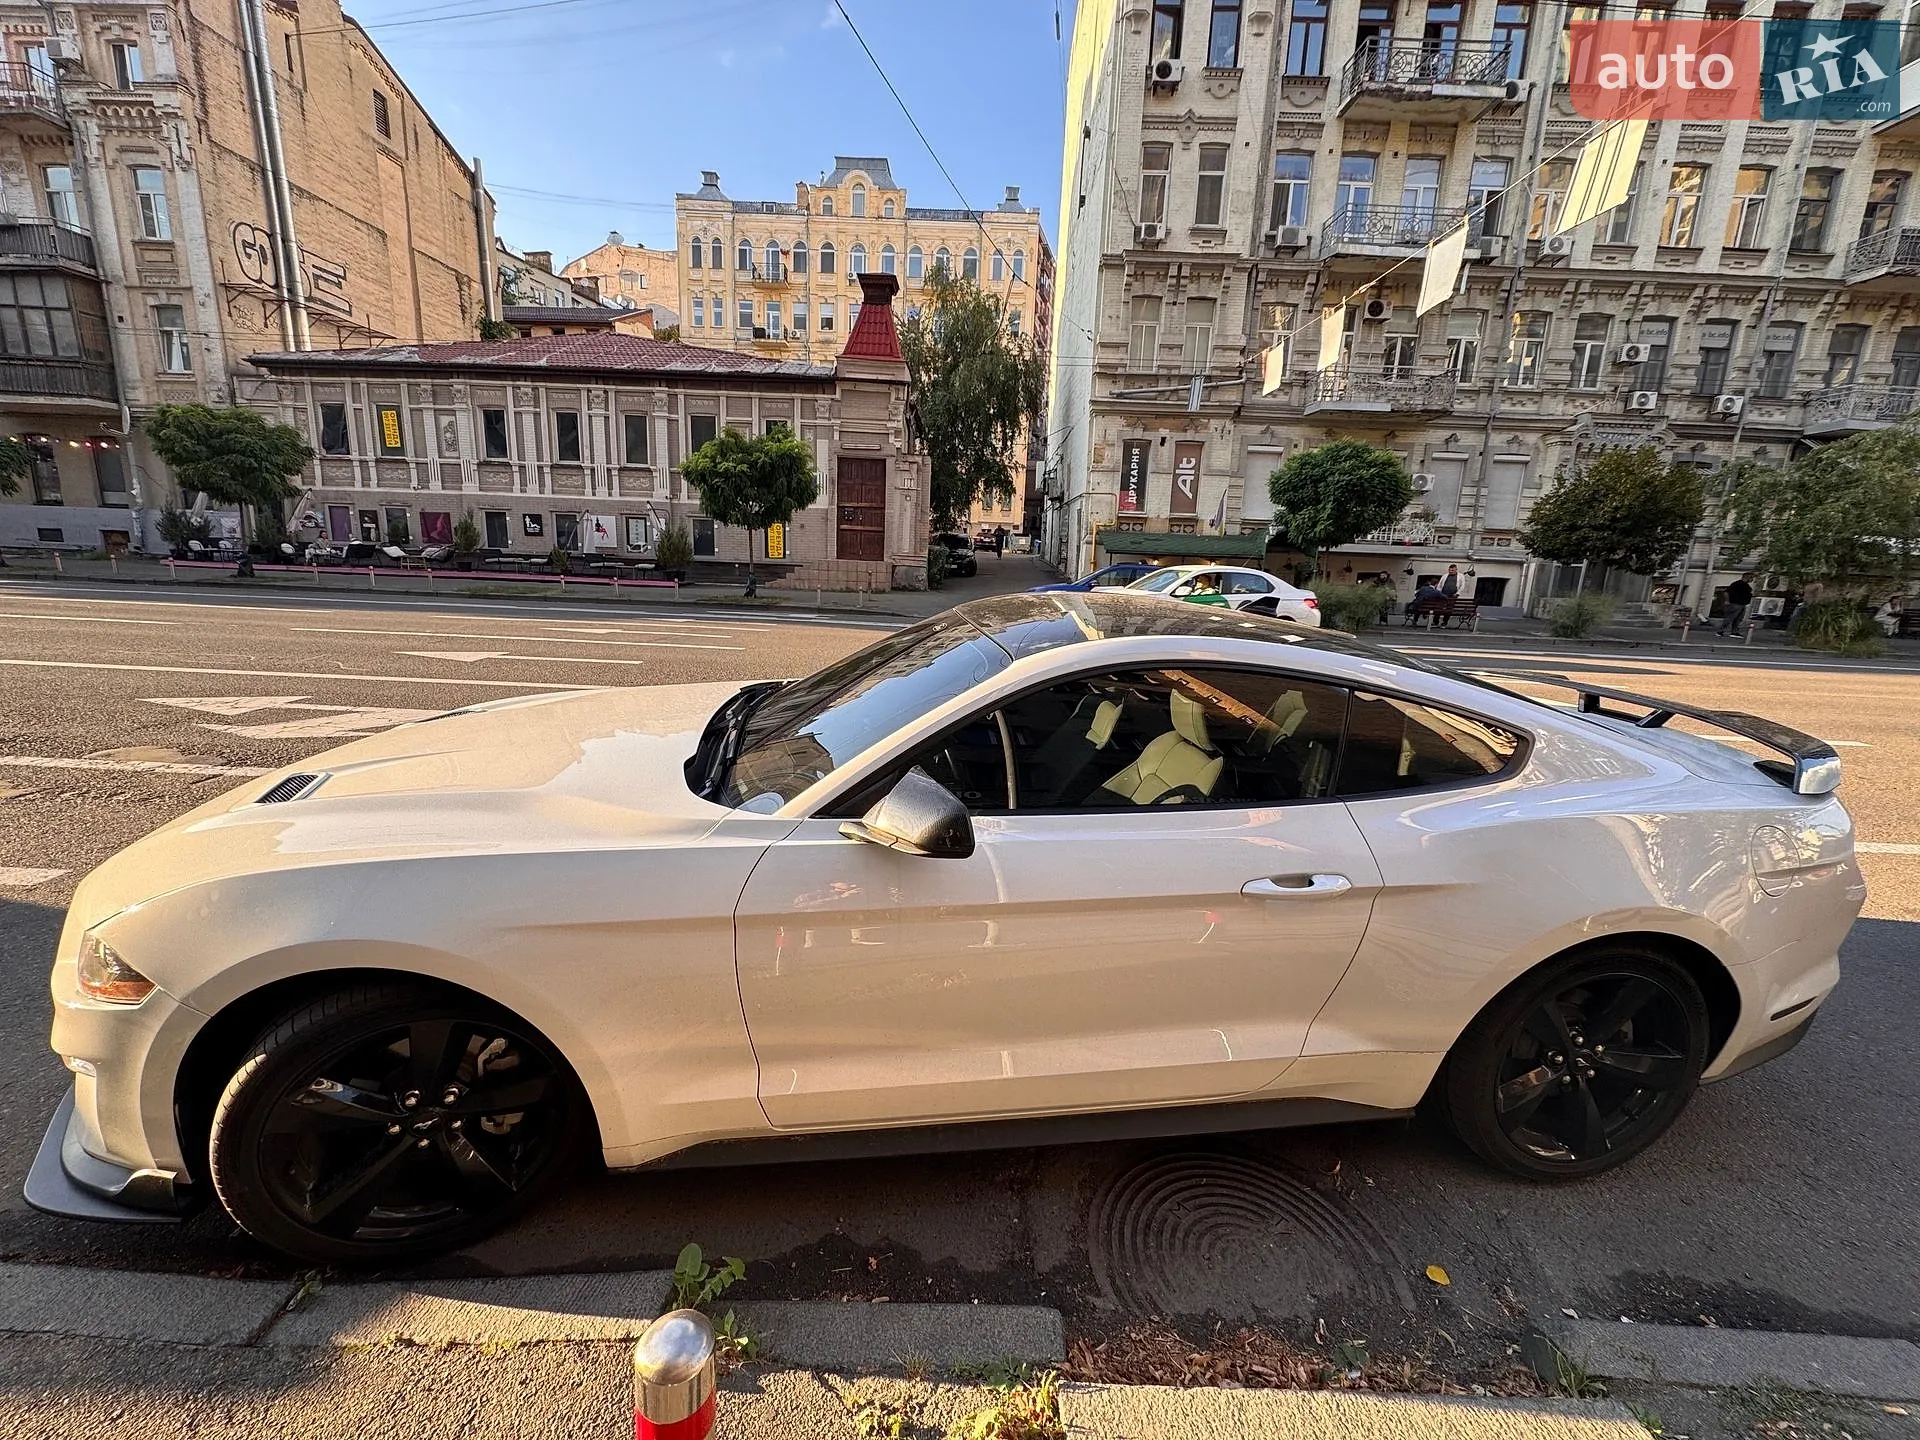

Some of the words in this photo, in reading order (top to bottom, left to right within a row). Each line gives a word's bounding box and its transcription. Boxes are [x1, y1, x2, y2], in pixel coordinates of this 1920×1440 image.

[390, 412, 399, 446] ОРЕНДА
[1128, 448, 1140, 504] ДРУКАРНЯ
[1175, 457, 1197, 500] Alt
